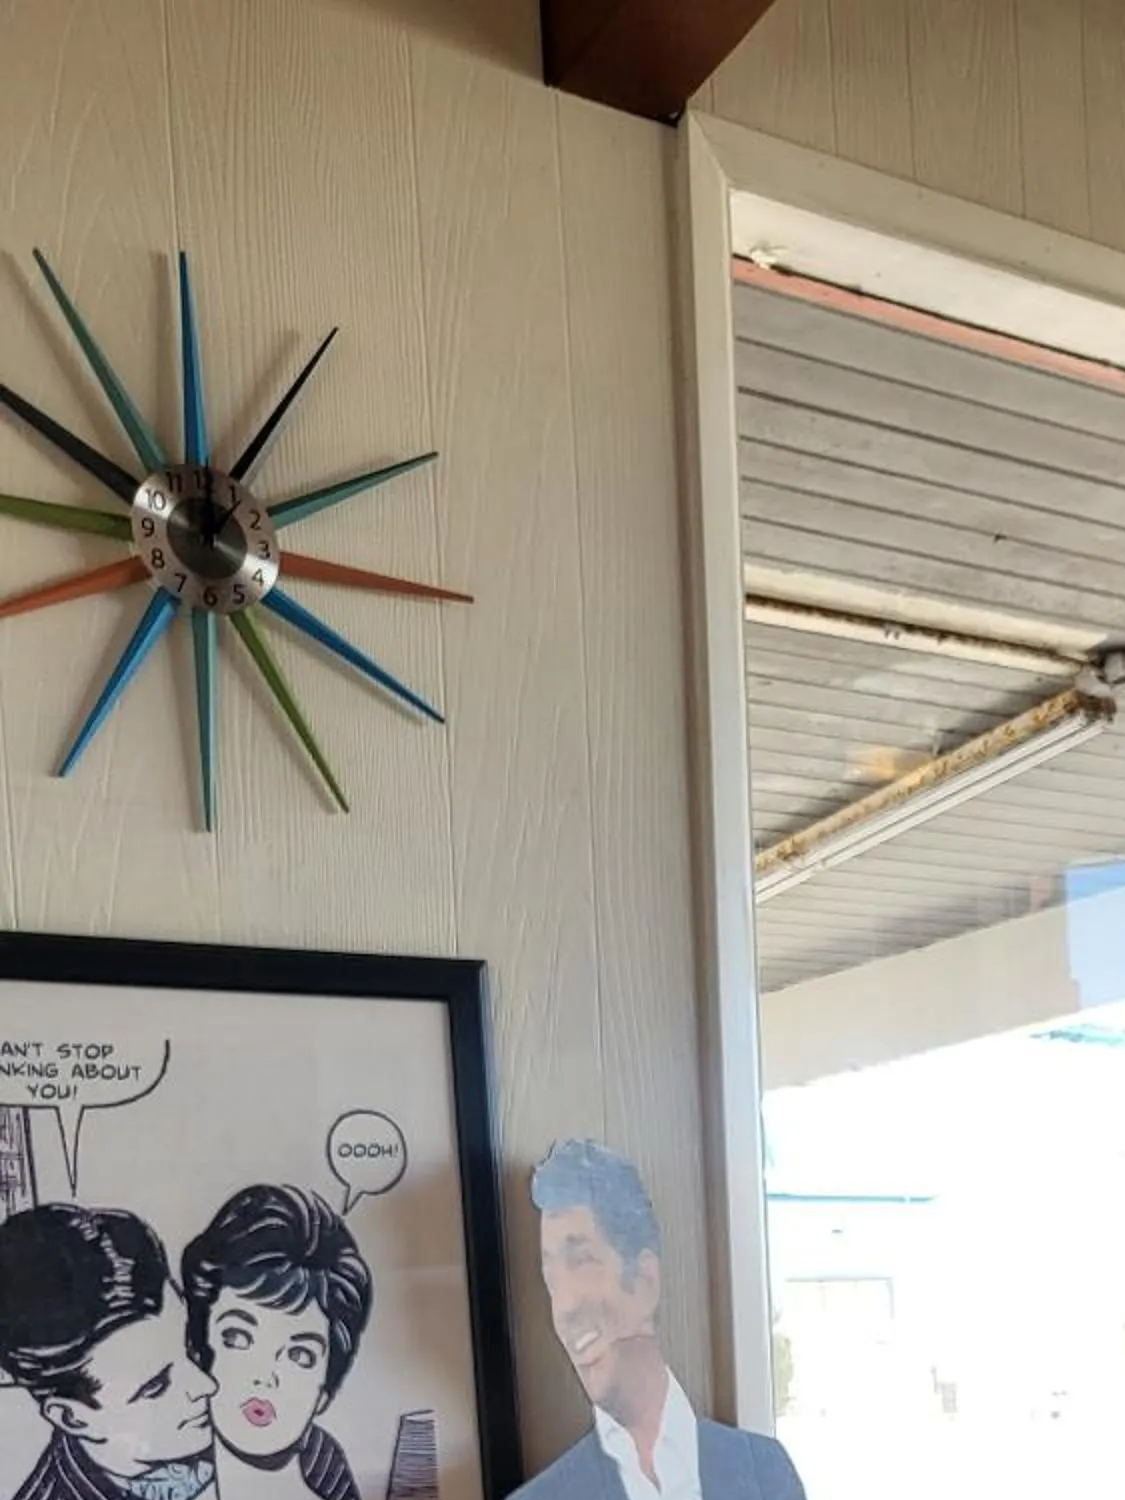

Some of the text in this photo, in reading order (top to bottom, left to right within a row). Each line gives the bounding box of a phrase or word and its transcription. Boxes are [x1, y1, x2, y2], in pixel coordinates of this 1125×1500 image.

[166, 472, 183, 493] 11
[145, 488, 166, 511] 10
[141, 517, 155, 537] 9
[249, 509, 261, 530] 2
[151, 547, 165, 569] 8
[257, 540, 271, 560] 3
[174, 572, 187, 593] 7
[252, 568, 265, 586] 4
[203, 586, 218, 607] 6
[232, 583, 245, 604] 5
[56, 1043, 114, 1060] STOP
[0, 1061, 142, 1081] NKING ABOUT
[26, 1083, 78, 1101] YOU!
[338, 1143, 399, 1158] OOOH!
